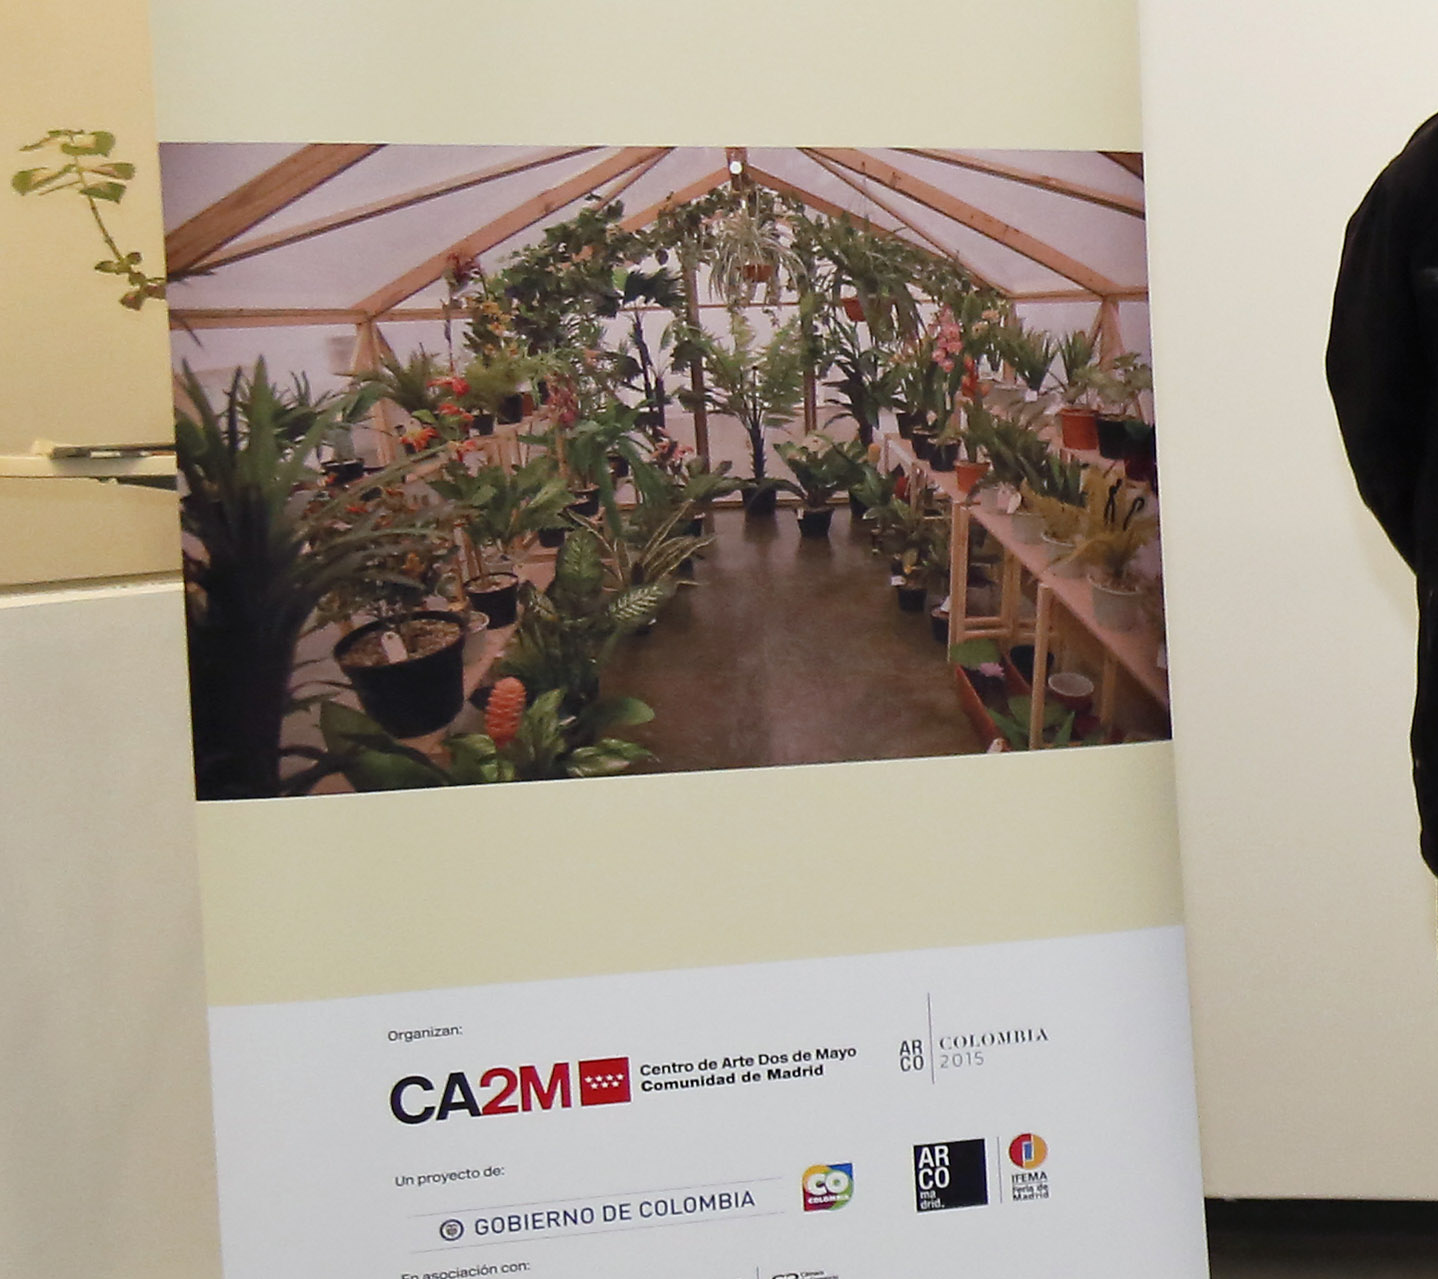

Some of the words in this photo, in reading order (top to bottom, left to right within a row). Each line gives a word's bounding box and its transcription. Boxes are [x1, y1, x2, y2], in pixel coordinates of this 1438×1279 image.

[388, 1025, 462, 1043] Organizan:
[939, 1028, 1048, 1050] COLOMBIA
[640, 1062, 694, 1077] Centro
[698, 1058, 717, 1071] de
[722, 1055, 754, 1069] Arte
[758, 1053, 788, 1066] Dos
[792, 1050, 812, 1064] de
[816, 1047, 856, 1066] Mayo
[940, 1052, 984, 1068] 2015
[641, 1072, 735, 1092] Comunidad
[742, 1071, 761, 1083] de
[767, 1064, 823, 1080] Madrid
[389, 1061, 572, 1124] CA2M
[395, 1176, 414, 1187] Un
[417, 1169, 480, 1187] proyecto
[483, 1165, 504, 1178] de:
[475, 1207, 594, 1236] GOBIERNO
[603, 1202, 631, 1223] DE
[639, 1190, 755, 1219] COLOMBIA
[501, 1262, 530, 1274] con:
